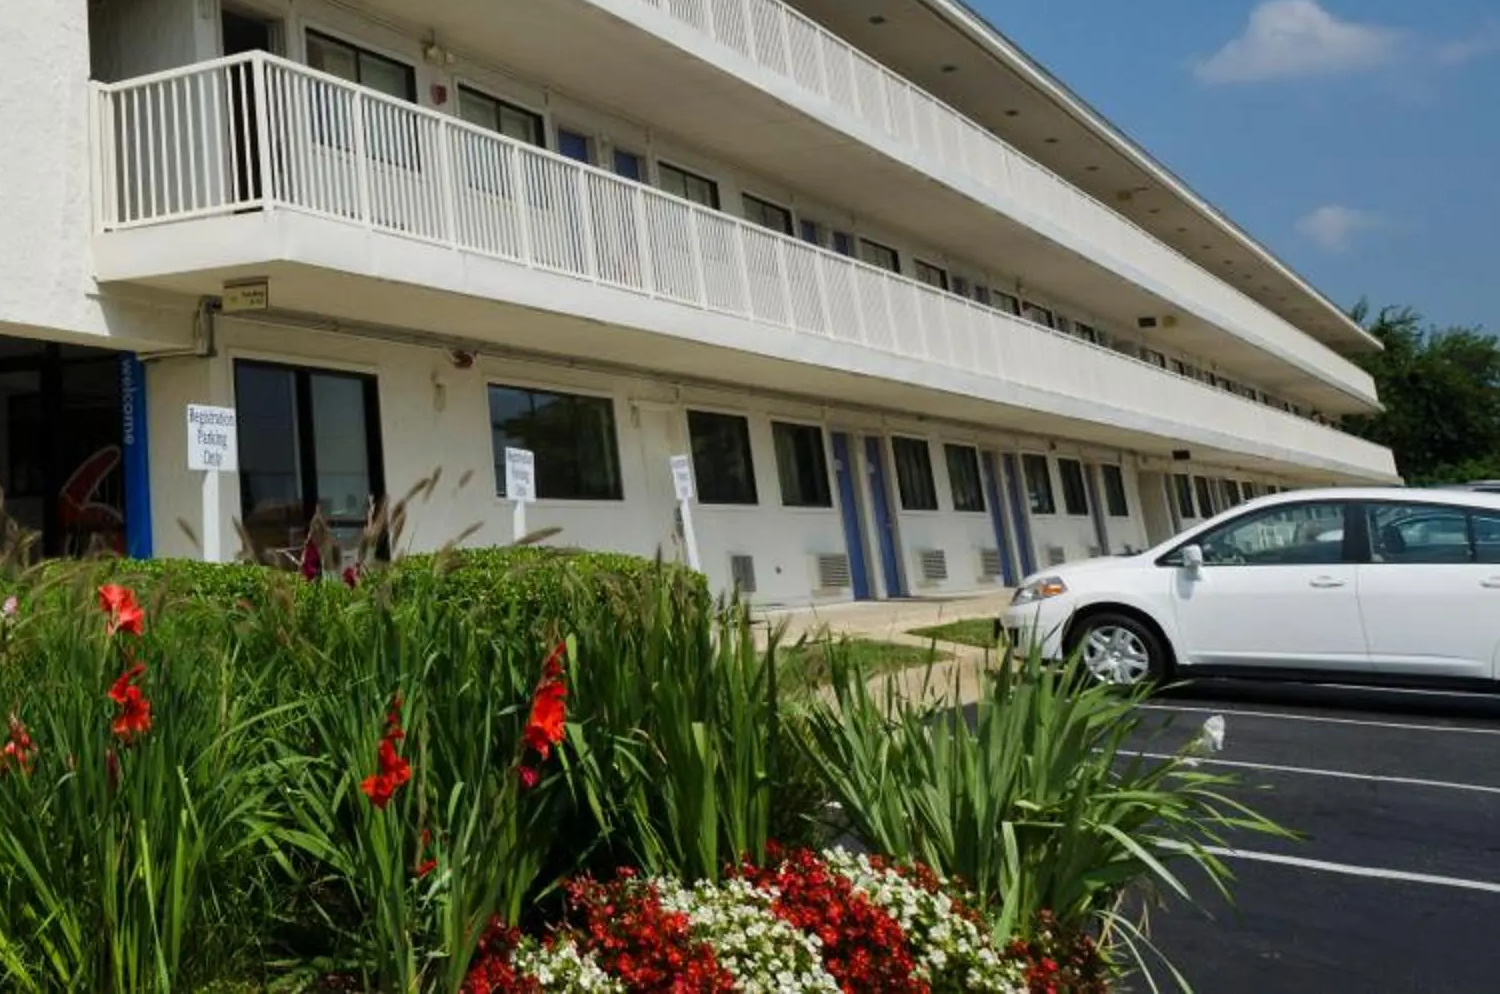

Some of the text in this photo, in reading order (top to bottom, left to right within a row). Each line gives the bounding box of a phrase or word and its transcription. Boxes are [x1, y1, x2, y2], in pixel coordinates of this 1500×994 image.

[121, 359, 138, 445] welcome
[189, 407, 236, 426] Registration
[197, 429, 228, 450] Parking
[203, 450, 222, 467] Only
